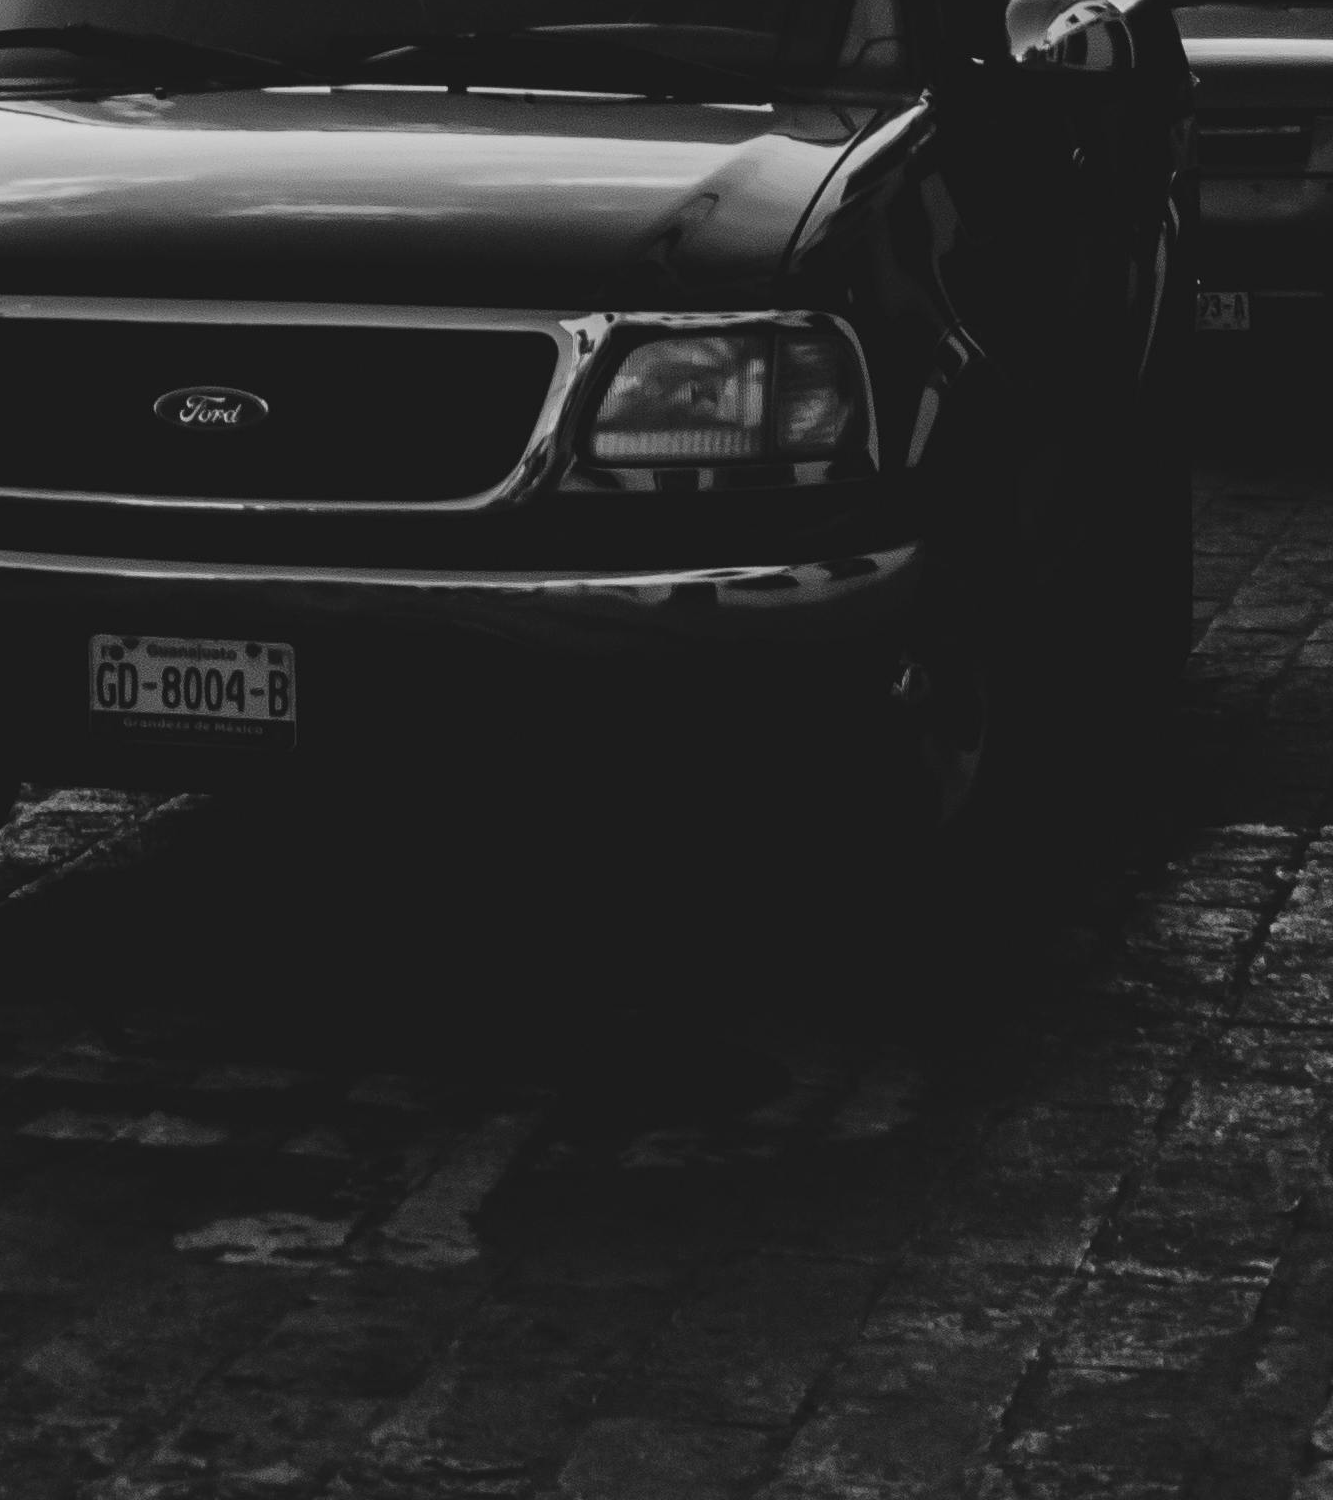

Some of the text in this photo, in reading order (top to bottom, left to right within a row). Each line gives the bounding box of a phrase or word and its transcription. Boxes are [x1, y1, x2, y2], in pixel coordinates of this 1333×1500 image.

[178, 394, 243, 424] Ford
[146, 643, 239, 662] Guanajuato
[96, 662, 290, 719] GD-8004-B
[194, 721, 211, 732] de
